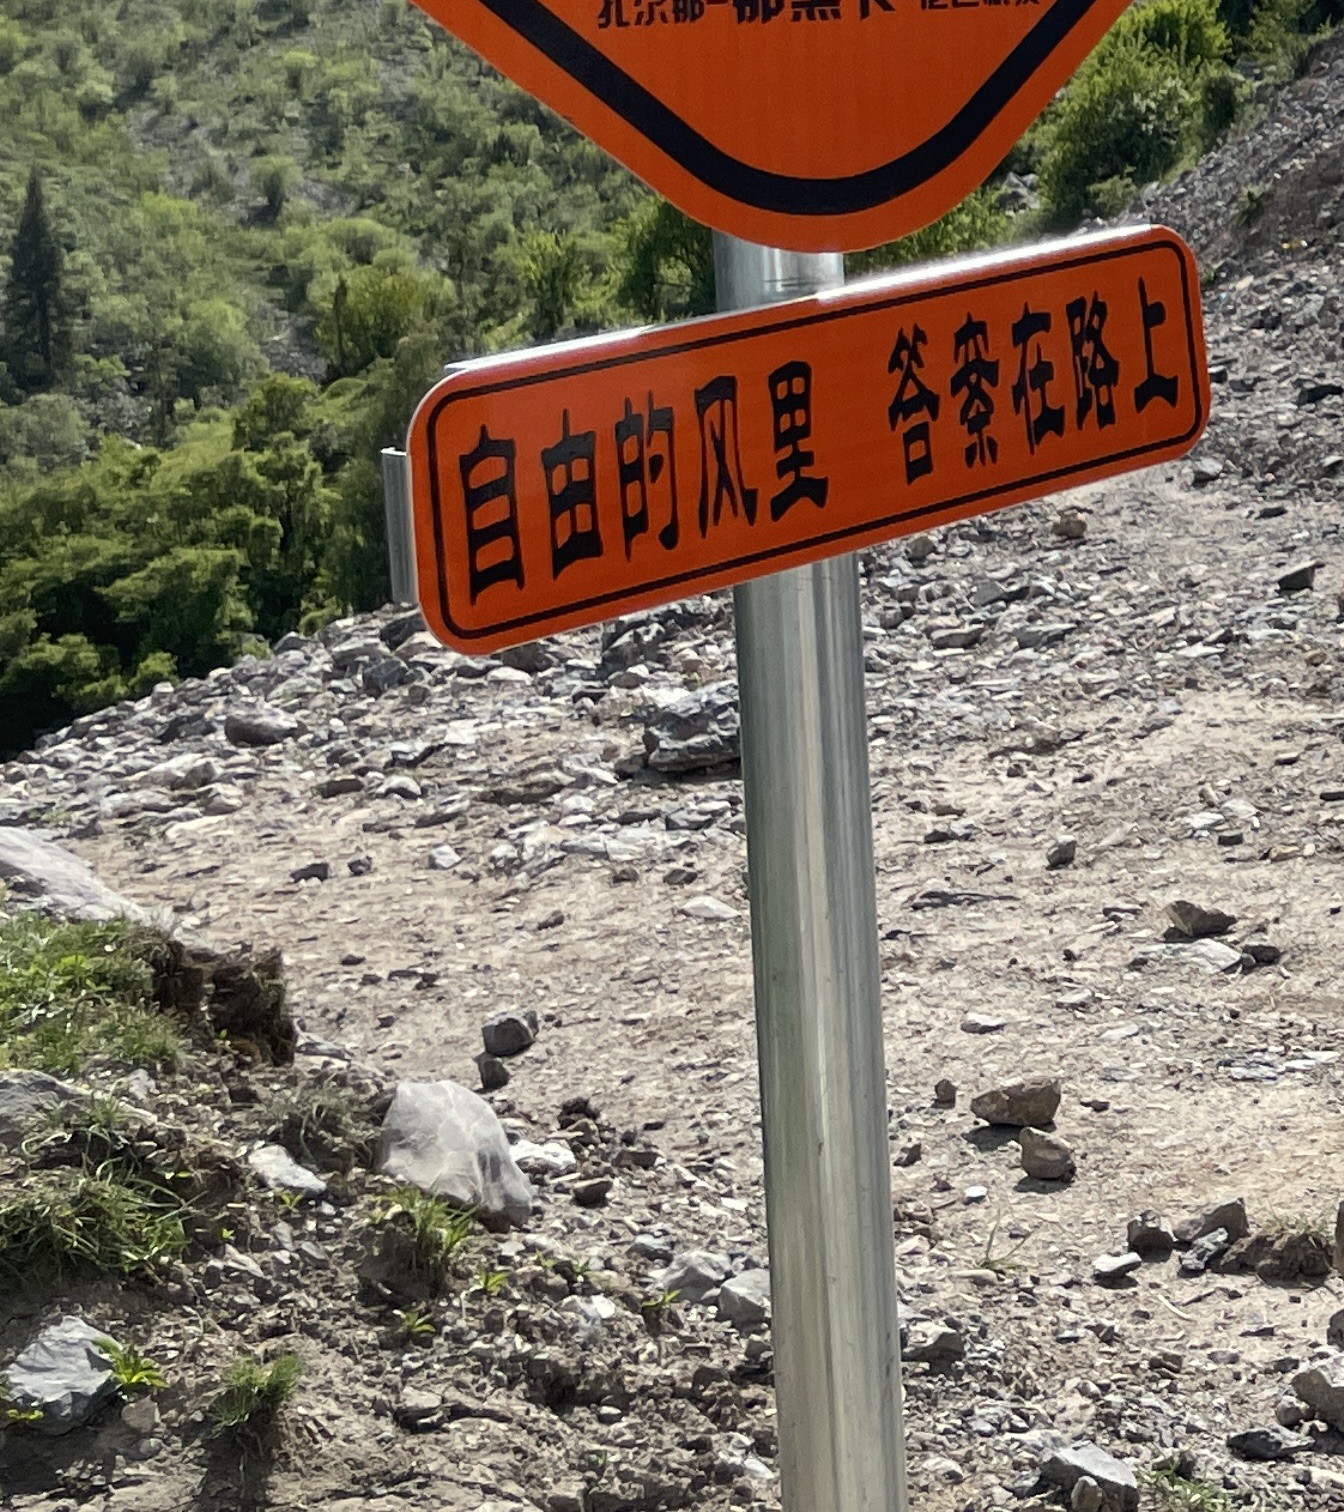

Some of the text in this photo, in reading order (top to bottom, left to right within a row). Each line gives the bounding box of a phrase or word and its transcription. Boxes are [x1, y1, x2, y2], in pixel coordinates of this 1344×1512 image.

[459, 277, 1179, 605] 自由的风里 答案在路上
